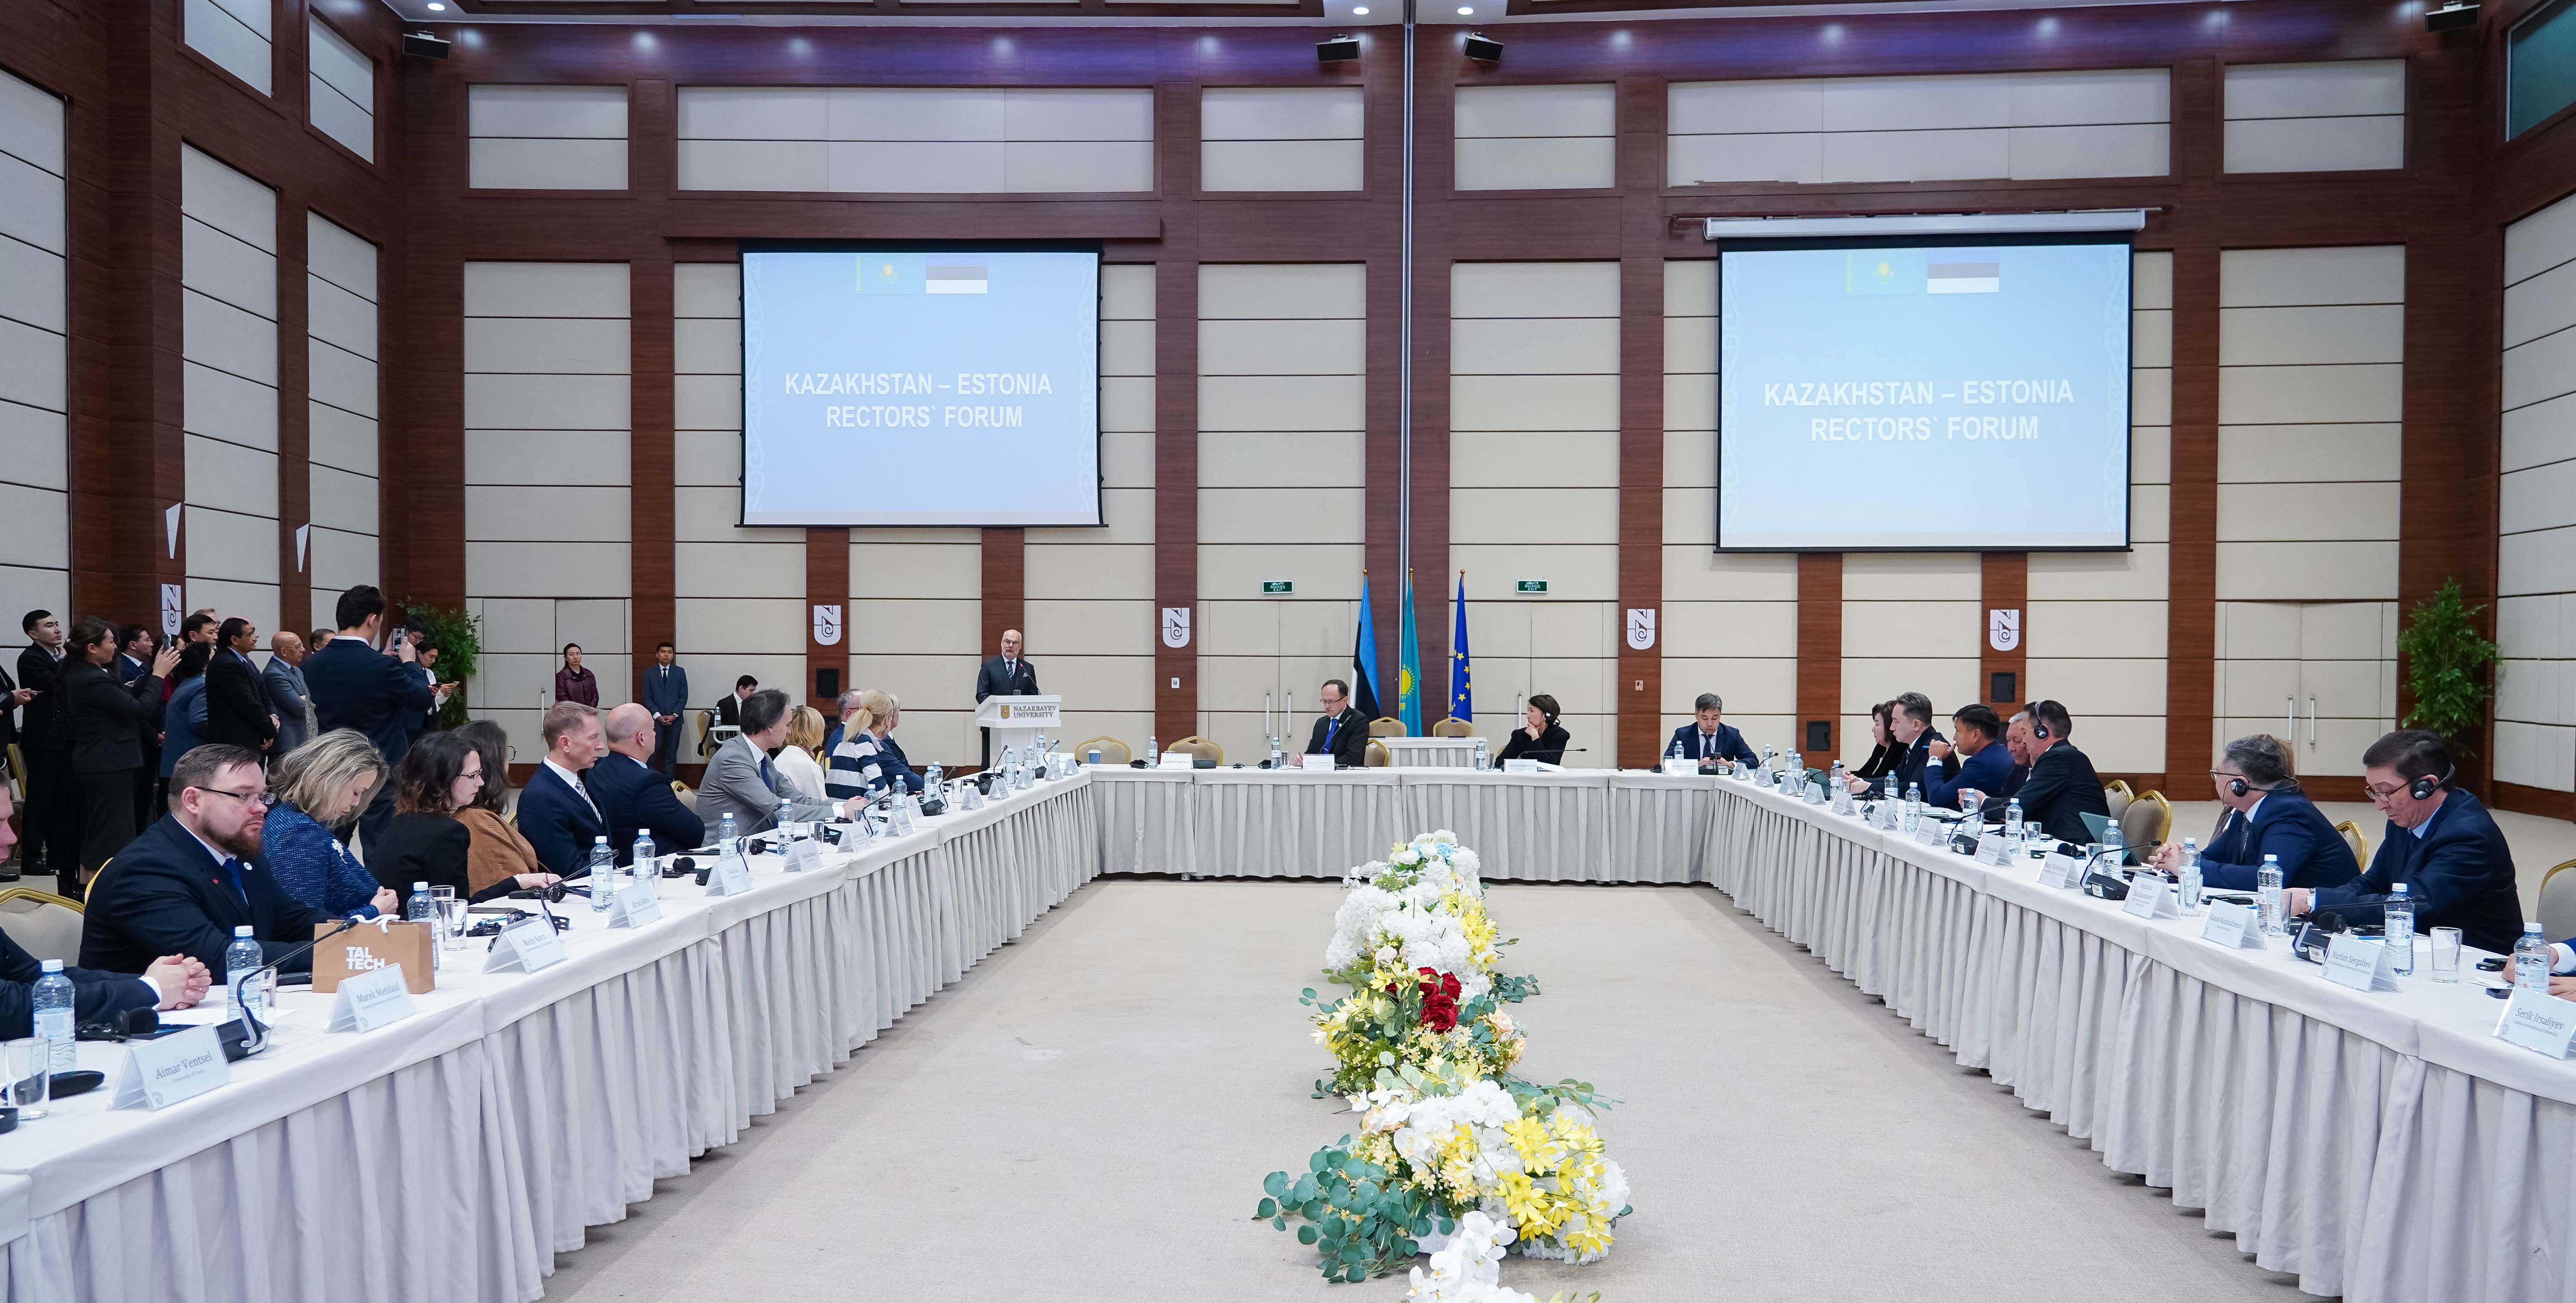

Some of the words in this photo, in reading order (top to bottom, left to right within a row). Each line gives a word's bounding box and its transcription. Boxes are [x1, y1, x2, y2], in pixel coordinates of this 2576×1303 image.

[785, 373, 932, 395] KAZAKHSTAN
[958, 373, 1053, 395] ESTONIA
[1765, 382, 1934, 406] KAZAKHSTAN
[1963, 379, 2074, 405] ESTONIA
[944, 406, 1022, 428] FORUM
[1948, 416, 2039, 440] FORUM
[346, 946, 372, 958] TAL
[2332, 950, 2348, 962] Nurlan
[2348, 955, 2372, 968] Sergaliev
[346, 958, 385, 970] TECH
[356, 990, 377, 1004] Marek
[375, 982, 400, 998] Metslaid
[2515, 1007, 2534, 1020] Serik
[2533, 1013, 2565, 1029] Irsaliyev
[156, 1064, 181, 1080] Aimar
[181, 1051, 213, 1070] Ventsel
